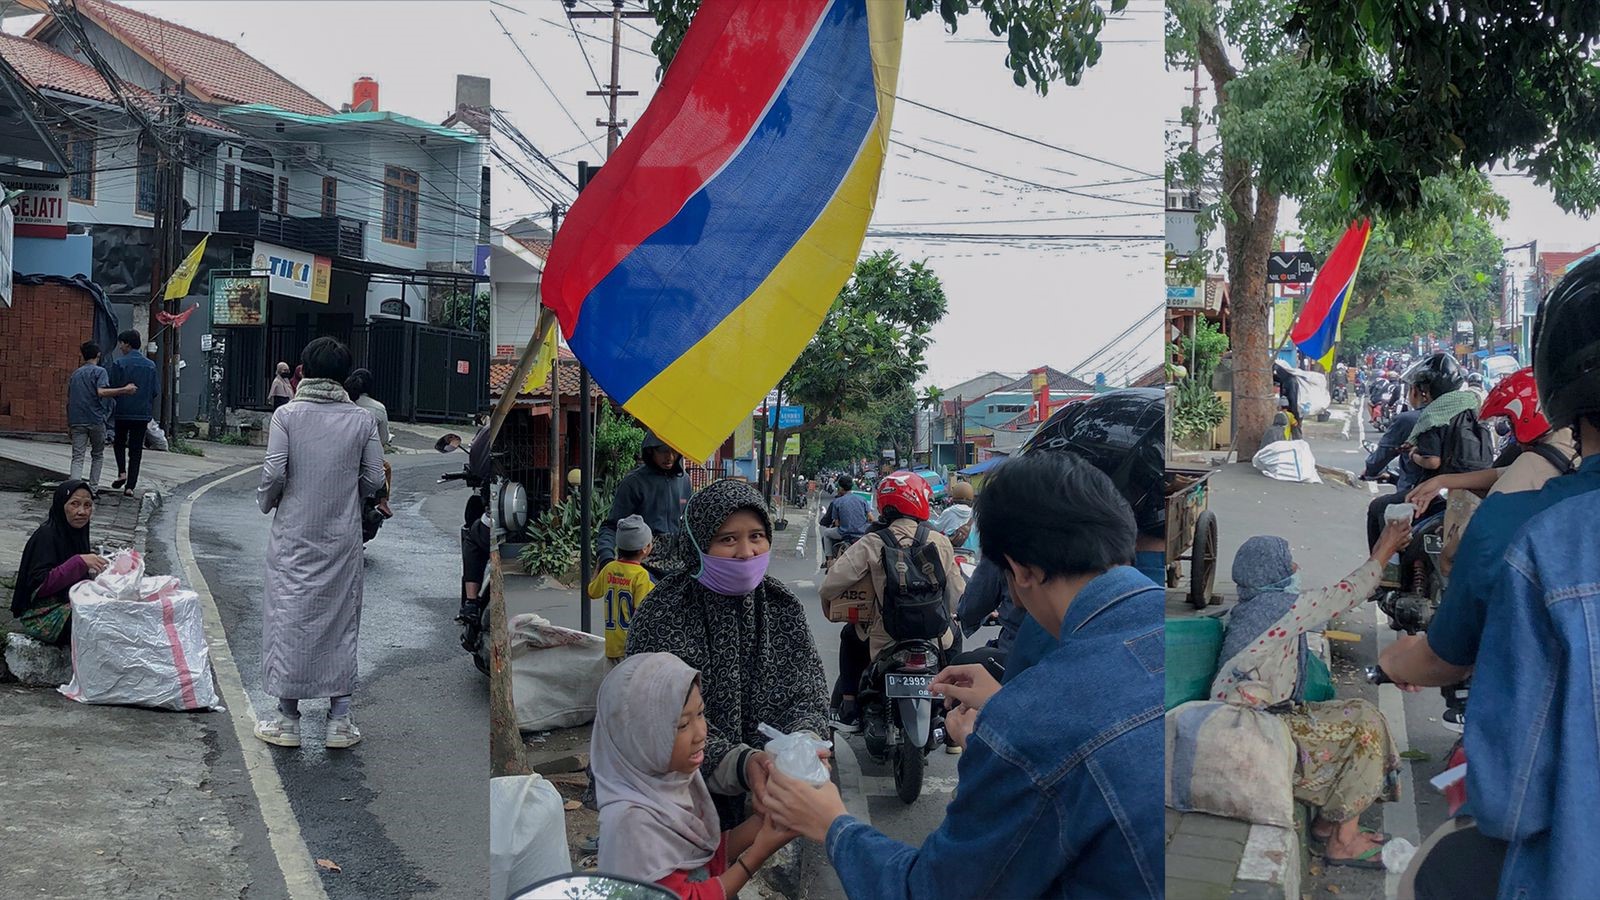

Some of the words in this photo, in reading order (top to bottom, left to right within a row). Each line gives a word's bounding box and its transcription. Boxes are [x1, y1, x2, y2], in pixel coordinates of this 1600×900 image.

[12, 195, 62, 218] SEJATI
[269, 256, 310, 282] TIKI
[1172, 298, 1188, 306] COPY
[840, 591, 867, 600] ABC
[605, 587, 634, 630] 10
[889, 676, 895, 685] D
[902, 676, 926, 686] 2993
